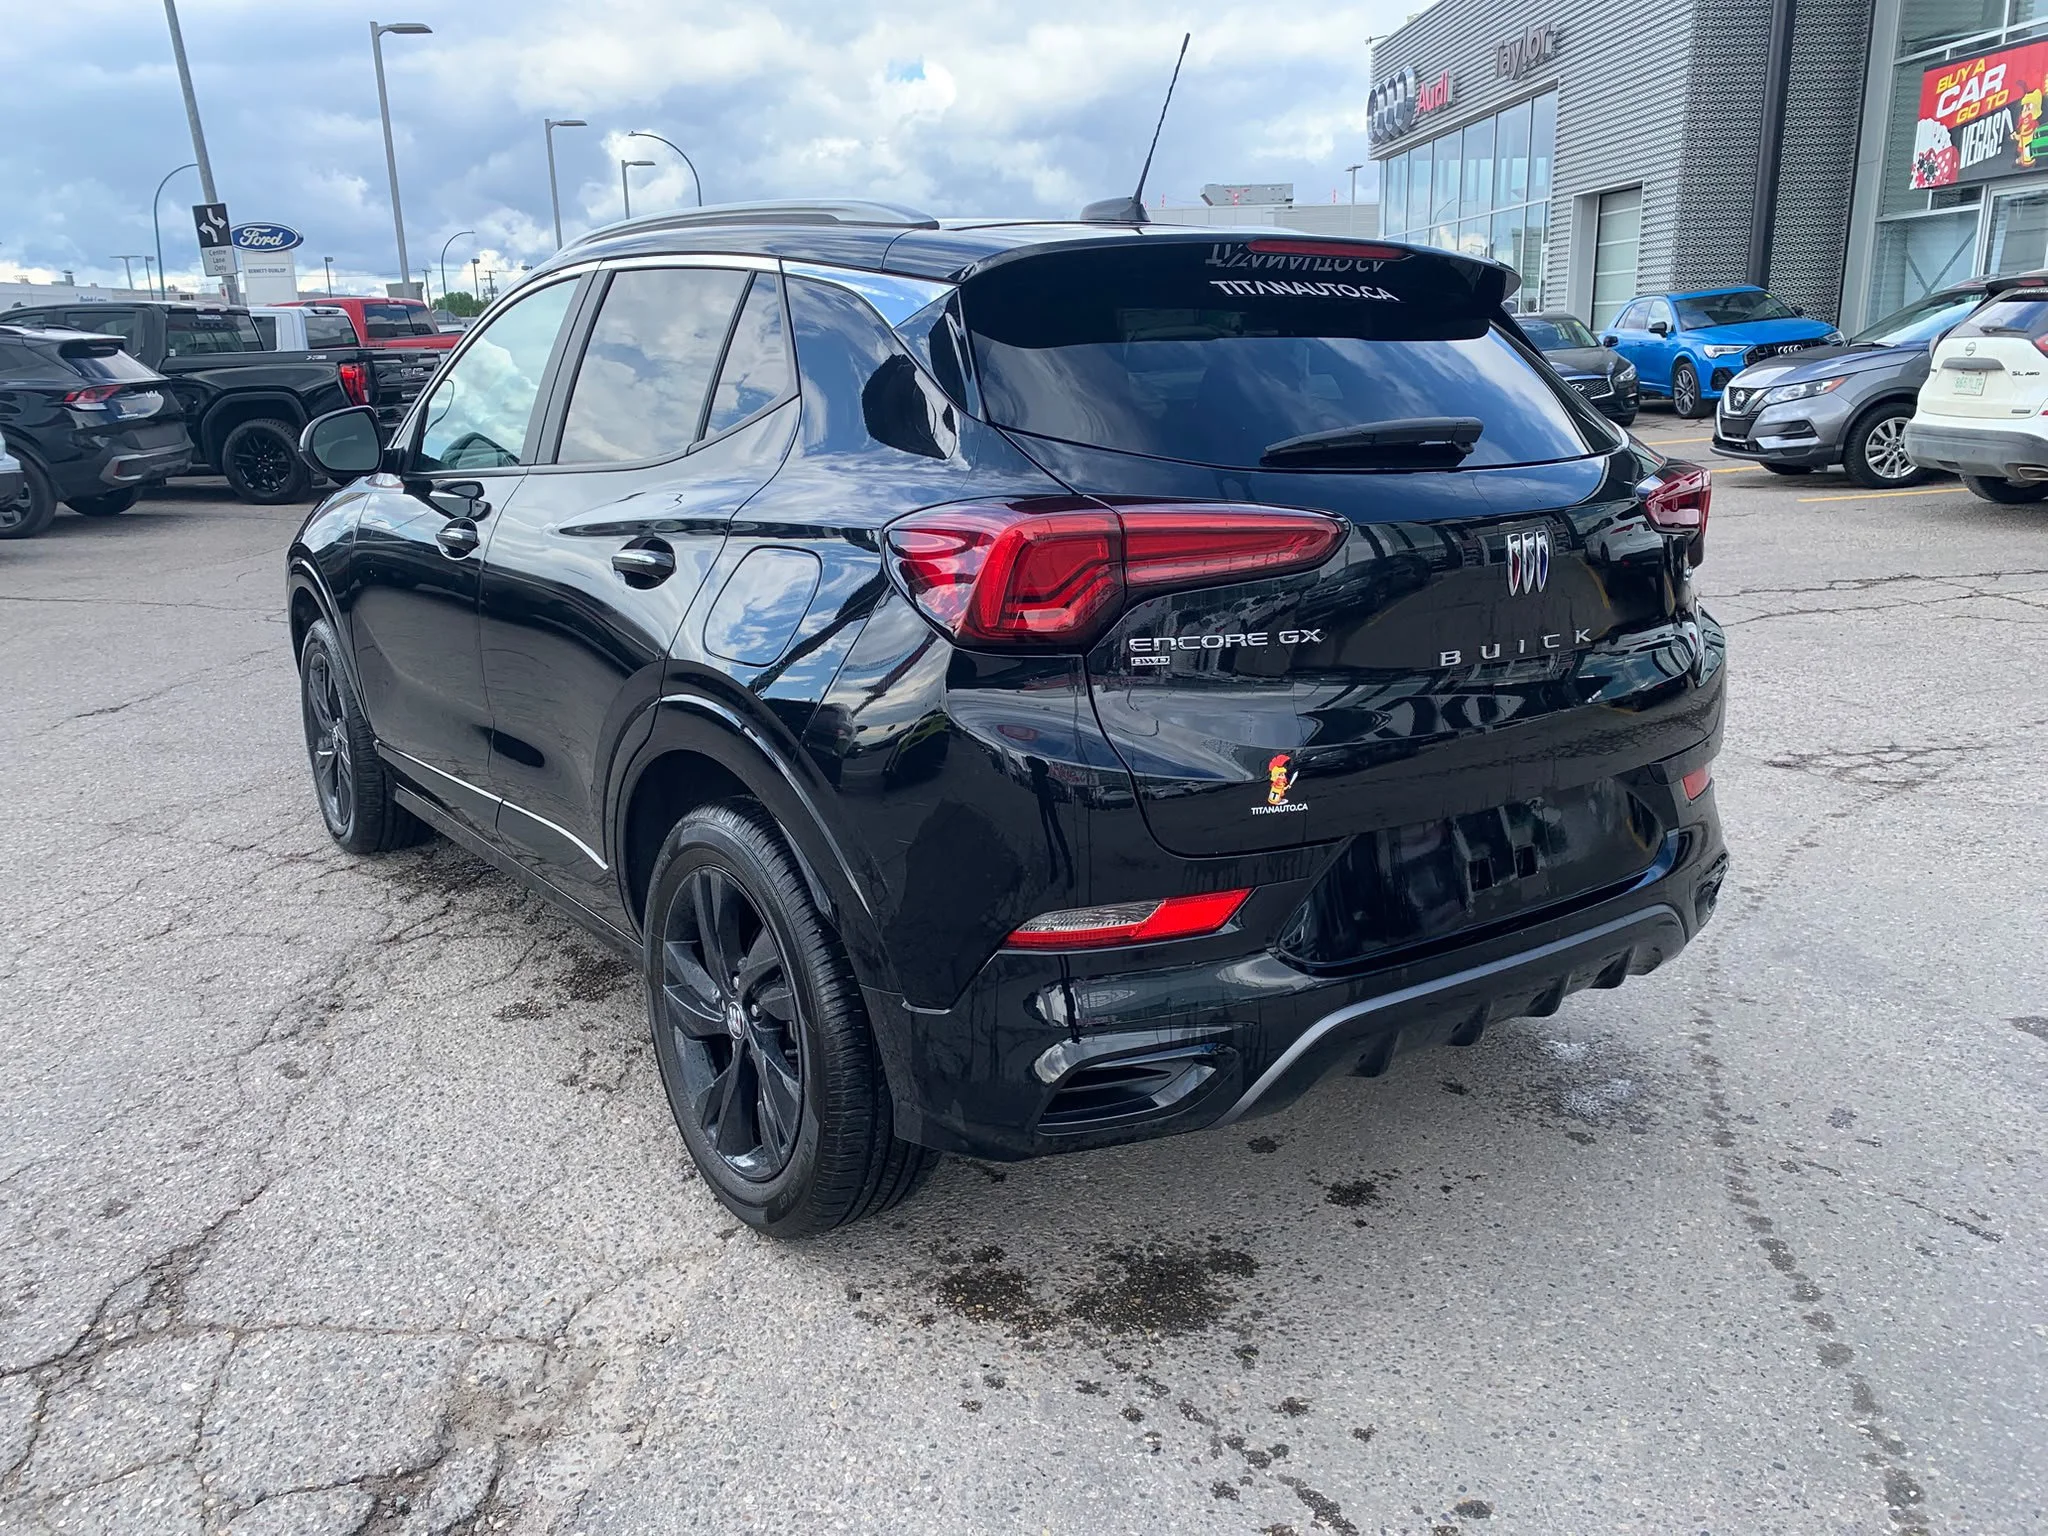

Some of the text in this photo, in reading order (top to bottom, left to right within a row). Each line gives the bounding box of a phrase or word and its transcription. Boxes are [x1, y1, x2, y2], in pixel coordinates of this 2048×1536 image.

[1495, 24, 1552, 80] Taylor
[1936, 58, 1986, 94] BUY A
[1936, 63, 2007, 118] CAR
[1417, 69, 1451, 116] Audi
[1956, 89, 2009, 124] GO TO
[1960, 108, 2008, 169] VEGAS!
[239, 227, 284, 246] Ford
[208, 249, 227, 257] Centre
[214, 264, 227, 272] Only
[1210, 280, 1401, 302] TITANAUTO.CA
[1129, 628, 1322, 652] ENCORE GX
[1440, 628, 1591, 667] BUICK
[1131, 656, 1170, 666] AWD
[1251, 803, 1309, 815] TITANAUTO.CA
